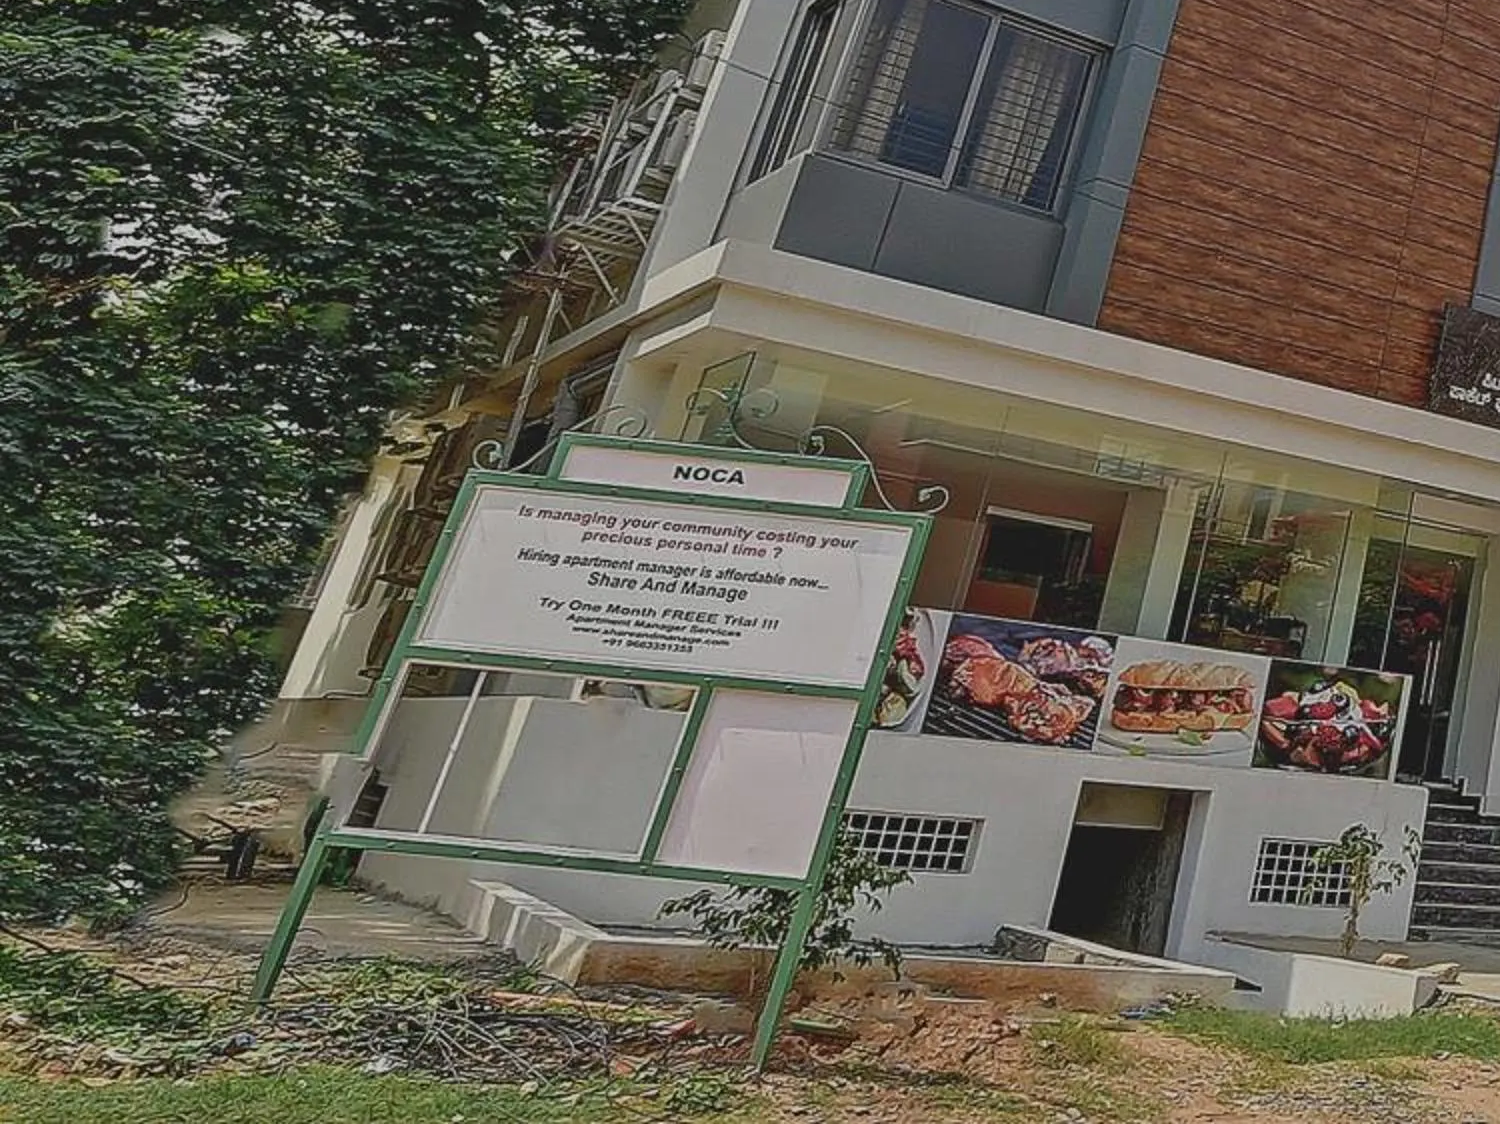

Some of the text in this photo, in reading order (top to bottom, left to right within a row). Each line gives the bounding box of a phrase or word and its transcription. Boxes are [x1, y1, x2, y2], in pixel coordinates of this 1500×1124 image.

[673, 465, 745, 485] NOCA
[518, 505, 859, 549] Is managing your community costing your
[581, 530, 784, 559] precious personal time ?
[517, 547, 561, 566] Hiring
[562, 554, 635, 572] apartment
[635, 561, 699, 578] manager
[699, 565, 713, 579] is
[715, 567, 786, 587] affordable
[587, 571, 749, 602] Share And Manage
[539, 596, 566, 611] Try
[568, 599, 603, 613] One
[605, 603, 658, 618] Month
[723, 613, 759, 628] Trial
[565, 613, 632, 627] Apartment
[633, 619, 687, 633] Manager
